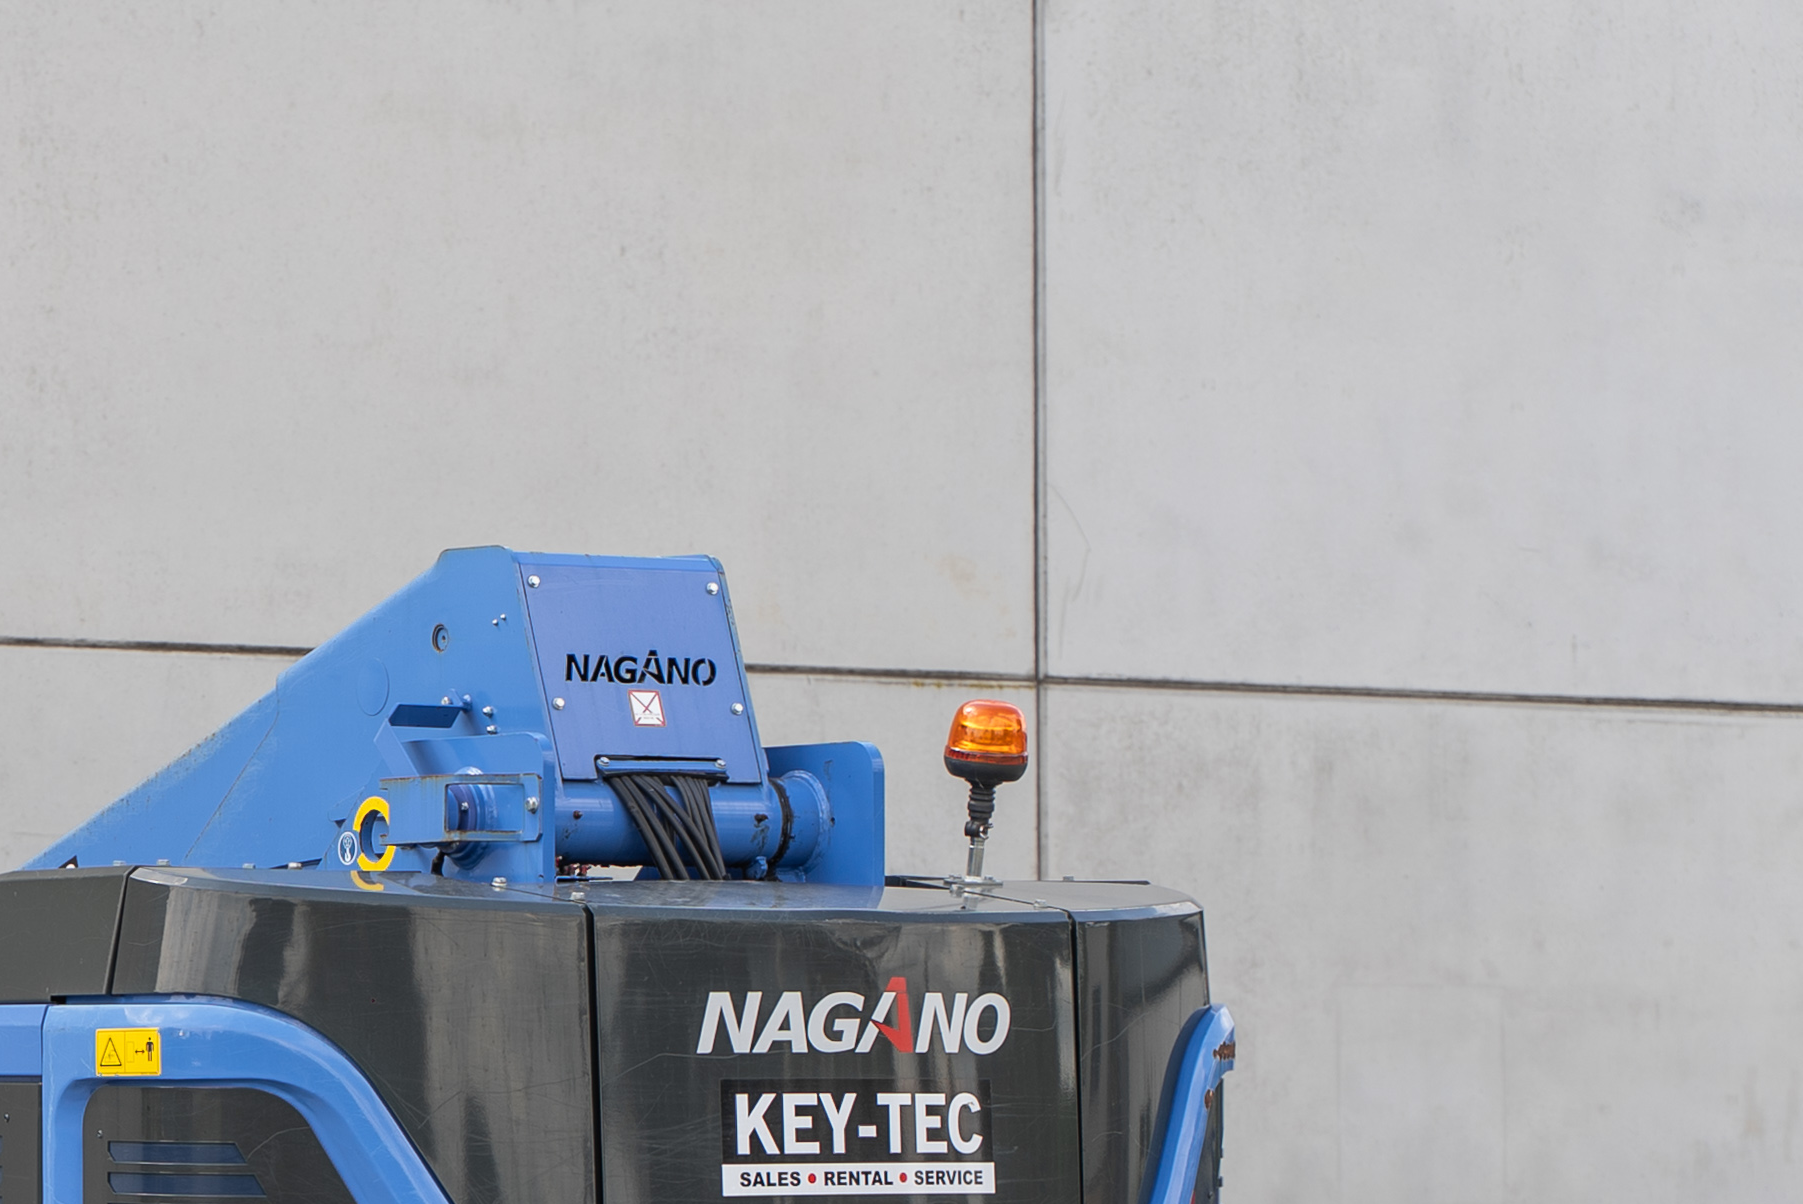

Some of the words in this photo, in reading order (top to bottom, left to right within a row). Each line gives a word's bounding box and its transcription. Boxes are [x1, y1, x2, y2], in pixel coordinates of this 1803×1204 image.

[565, 650, 717, 687] NAGANO
[696, 976, 1011, 1055] NAGANO
[735, 1092, 984, 1155] KEY-TEC
[739, 1171, 802, 1187] SALES
[823, 1170, 894, 1186] RENTAL
[914, 1169, 984, 1186] SERVICE
